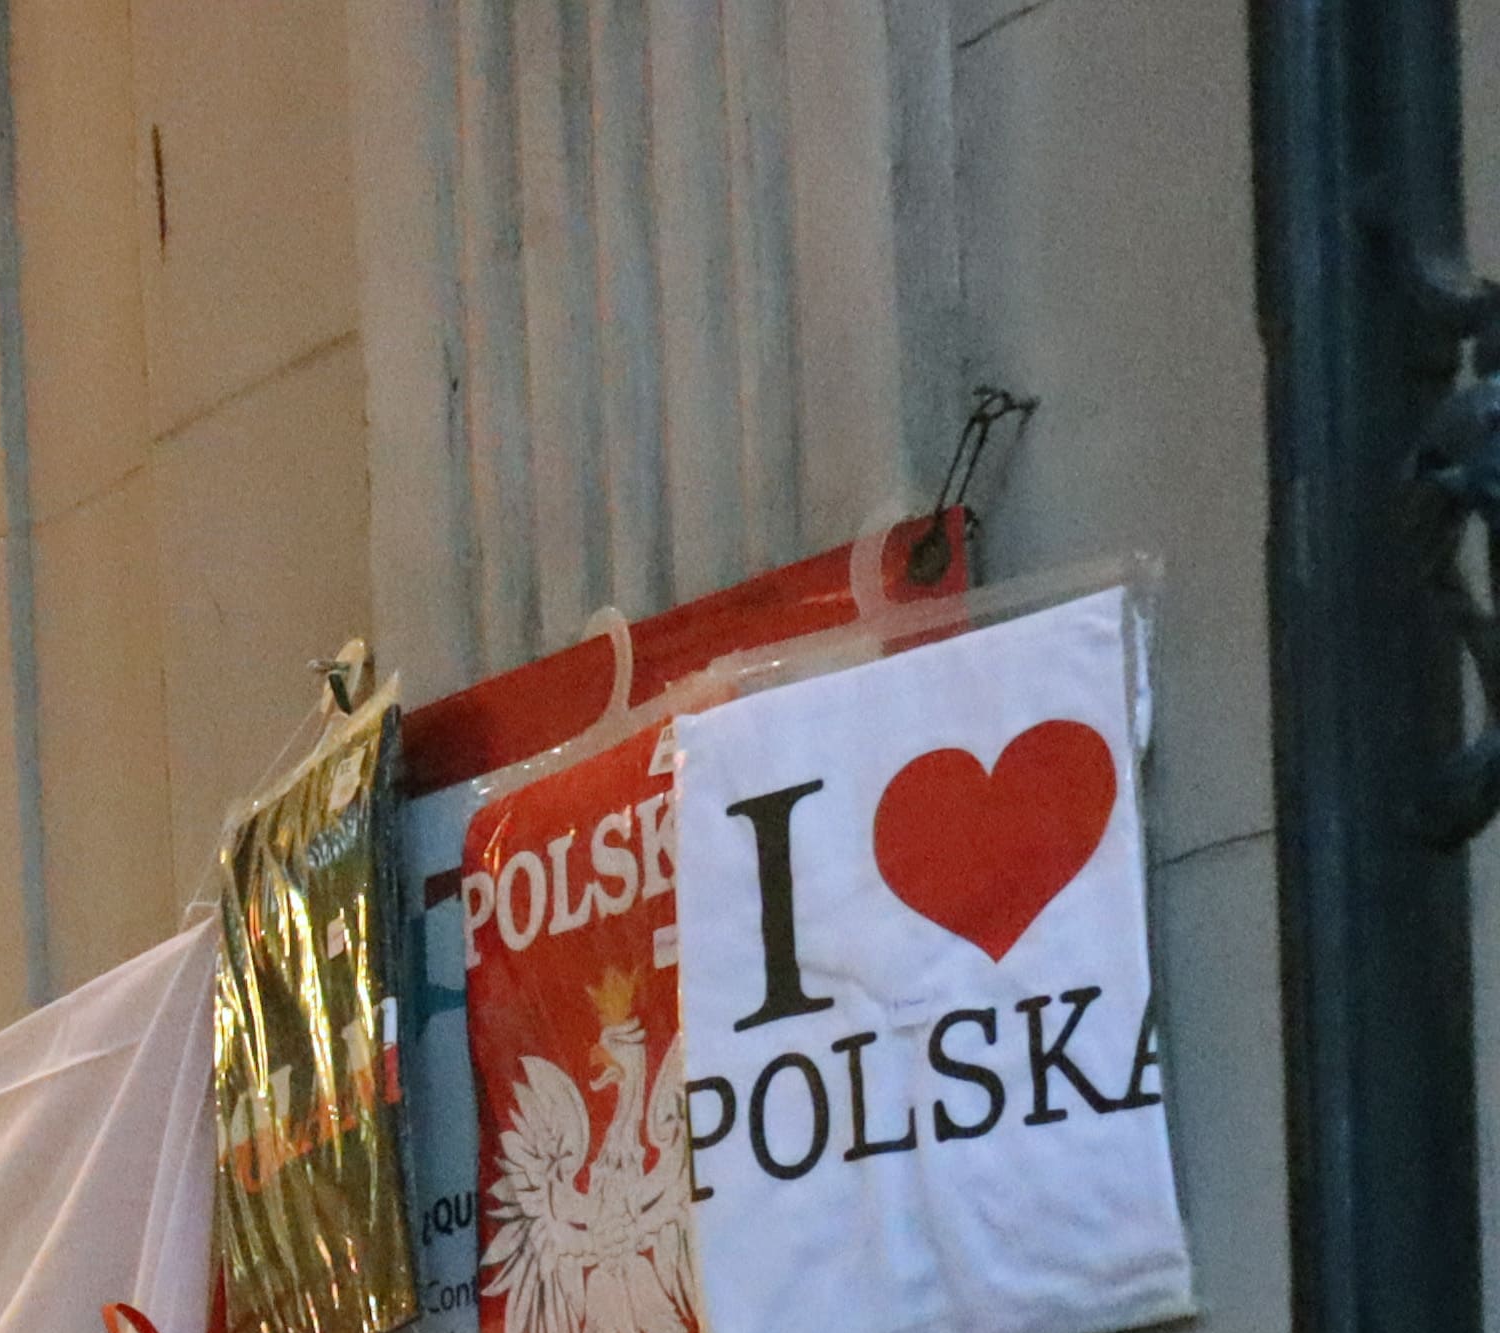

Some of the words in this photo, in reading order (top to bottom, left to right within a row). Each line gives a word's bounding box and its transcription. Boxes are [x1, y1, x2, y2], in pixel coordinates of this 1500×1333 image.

[462, 793, 676, 969] POLSK
[726, 779, 835, 1033] I
[422, 1191, 472, 1247] ¿QU
